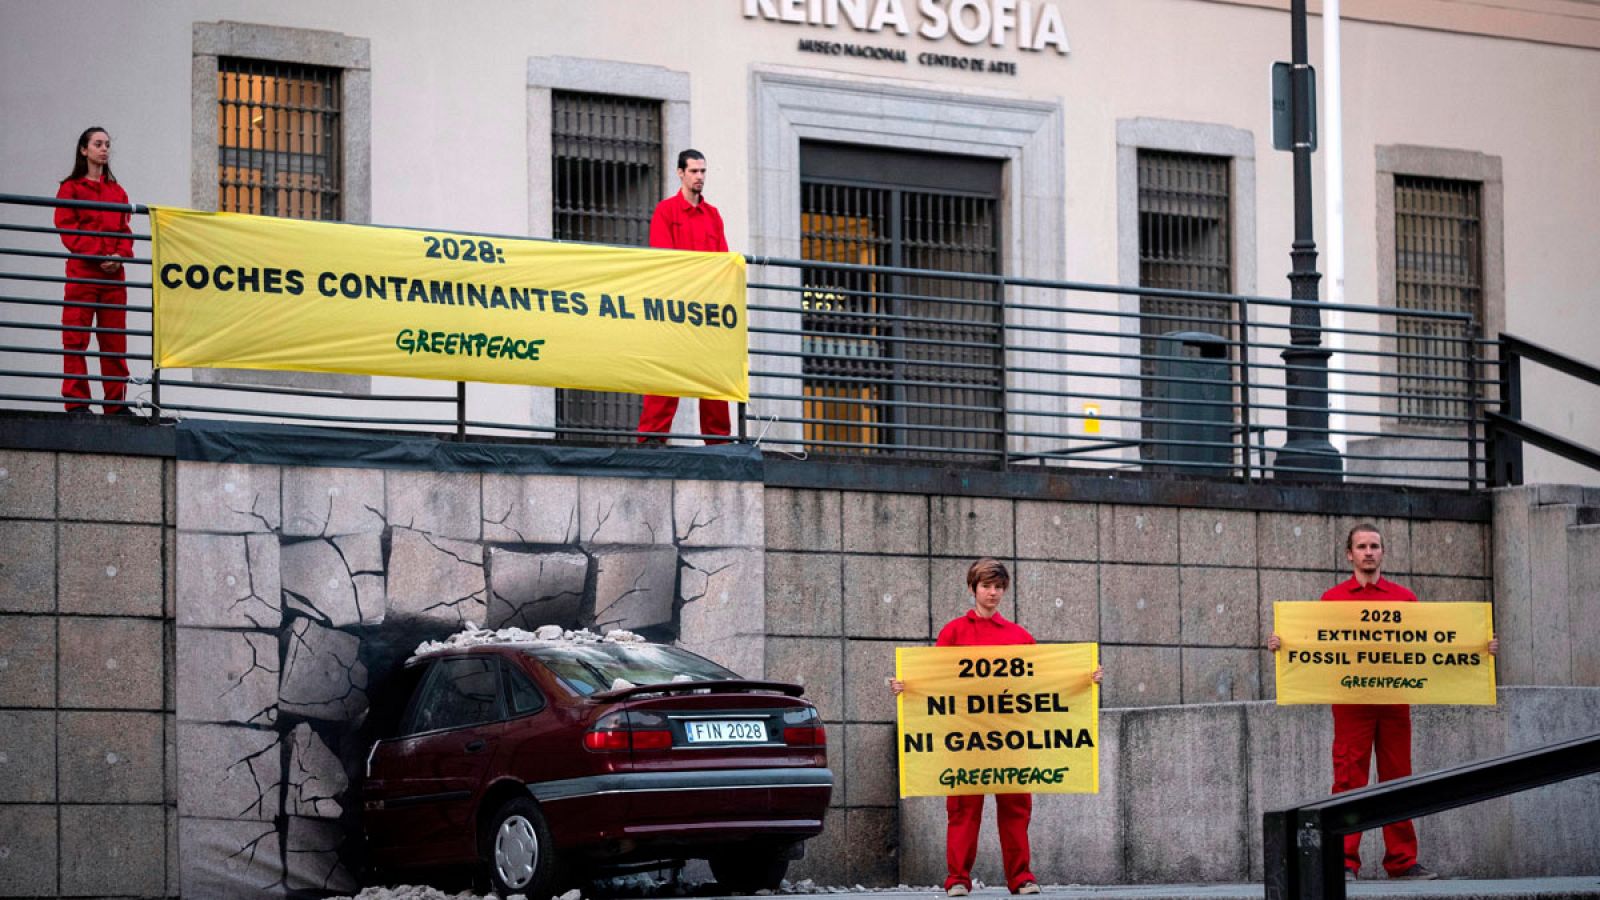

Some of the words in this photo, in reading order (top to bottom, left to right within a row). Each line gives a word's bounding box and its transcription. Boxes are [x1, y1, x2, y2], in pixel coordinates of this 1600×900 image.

[798, 39, 842, 56] MUSEO
[918, 52, 968, 69] CENTRO
[970, 58, 984, 72] DE
[988, 60, 1017, 76] ARTE
[424, 235, 505, 263] 2028:
[160, 263, 305, 295] COCHES
[318, 272, 589, 315] CONTAMINANTES
[599, 294, 635, 319] AL
[643, 297, 738, 329] MUSEO
[396, 329, 545, 360] GREENPEACE
[1360, 609, 1402, 623] 2028
[1317, 630, 1428, 643] EXTINCTION
[1434, 631, 1457, 643] OF
[958, 658, 1034, 678] 2028:
[1288, 651, 1351, 665] FOSSIL
[1357, 652, 1427, 665] FUELED
[1432, 653, 1481, 666] CARS
[1340, 675, 1428, 689] GREENPEACE
[927, 696, 956, 716] NI
[967, 689, 1069, 714] DIÉSEL
[695, 723, 722, 739] FIN
[726, 723, 762, 739] 2028
[904, 733, 934, 752] NI
[944, 729, 1095, 752] GASOLINA
[939, 767, 1069, 788] GREENPEACE
